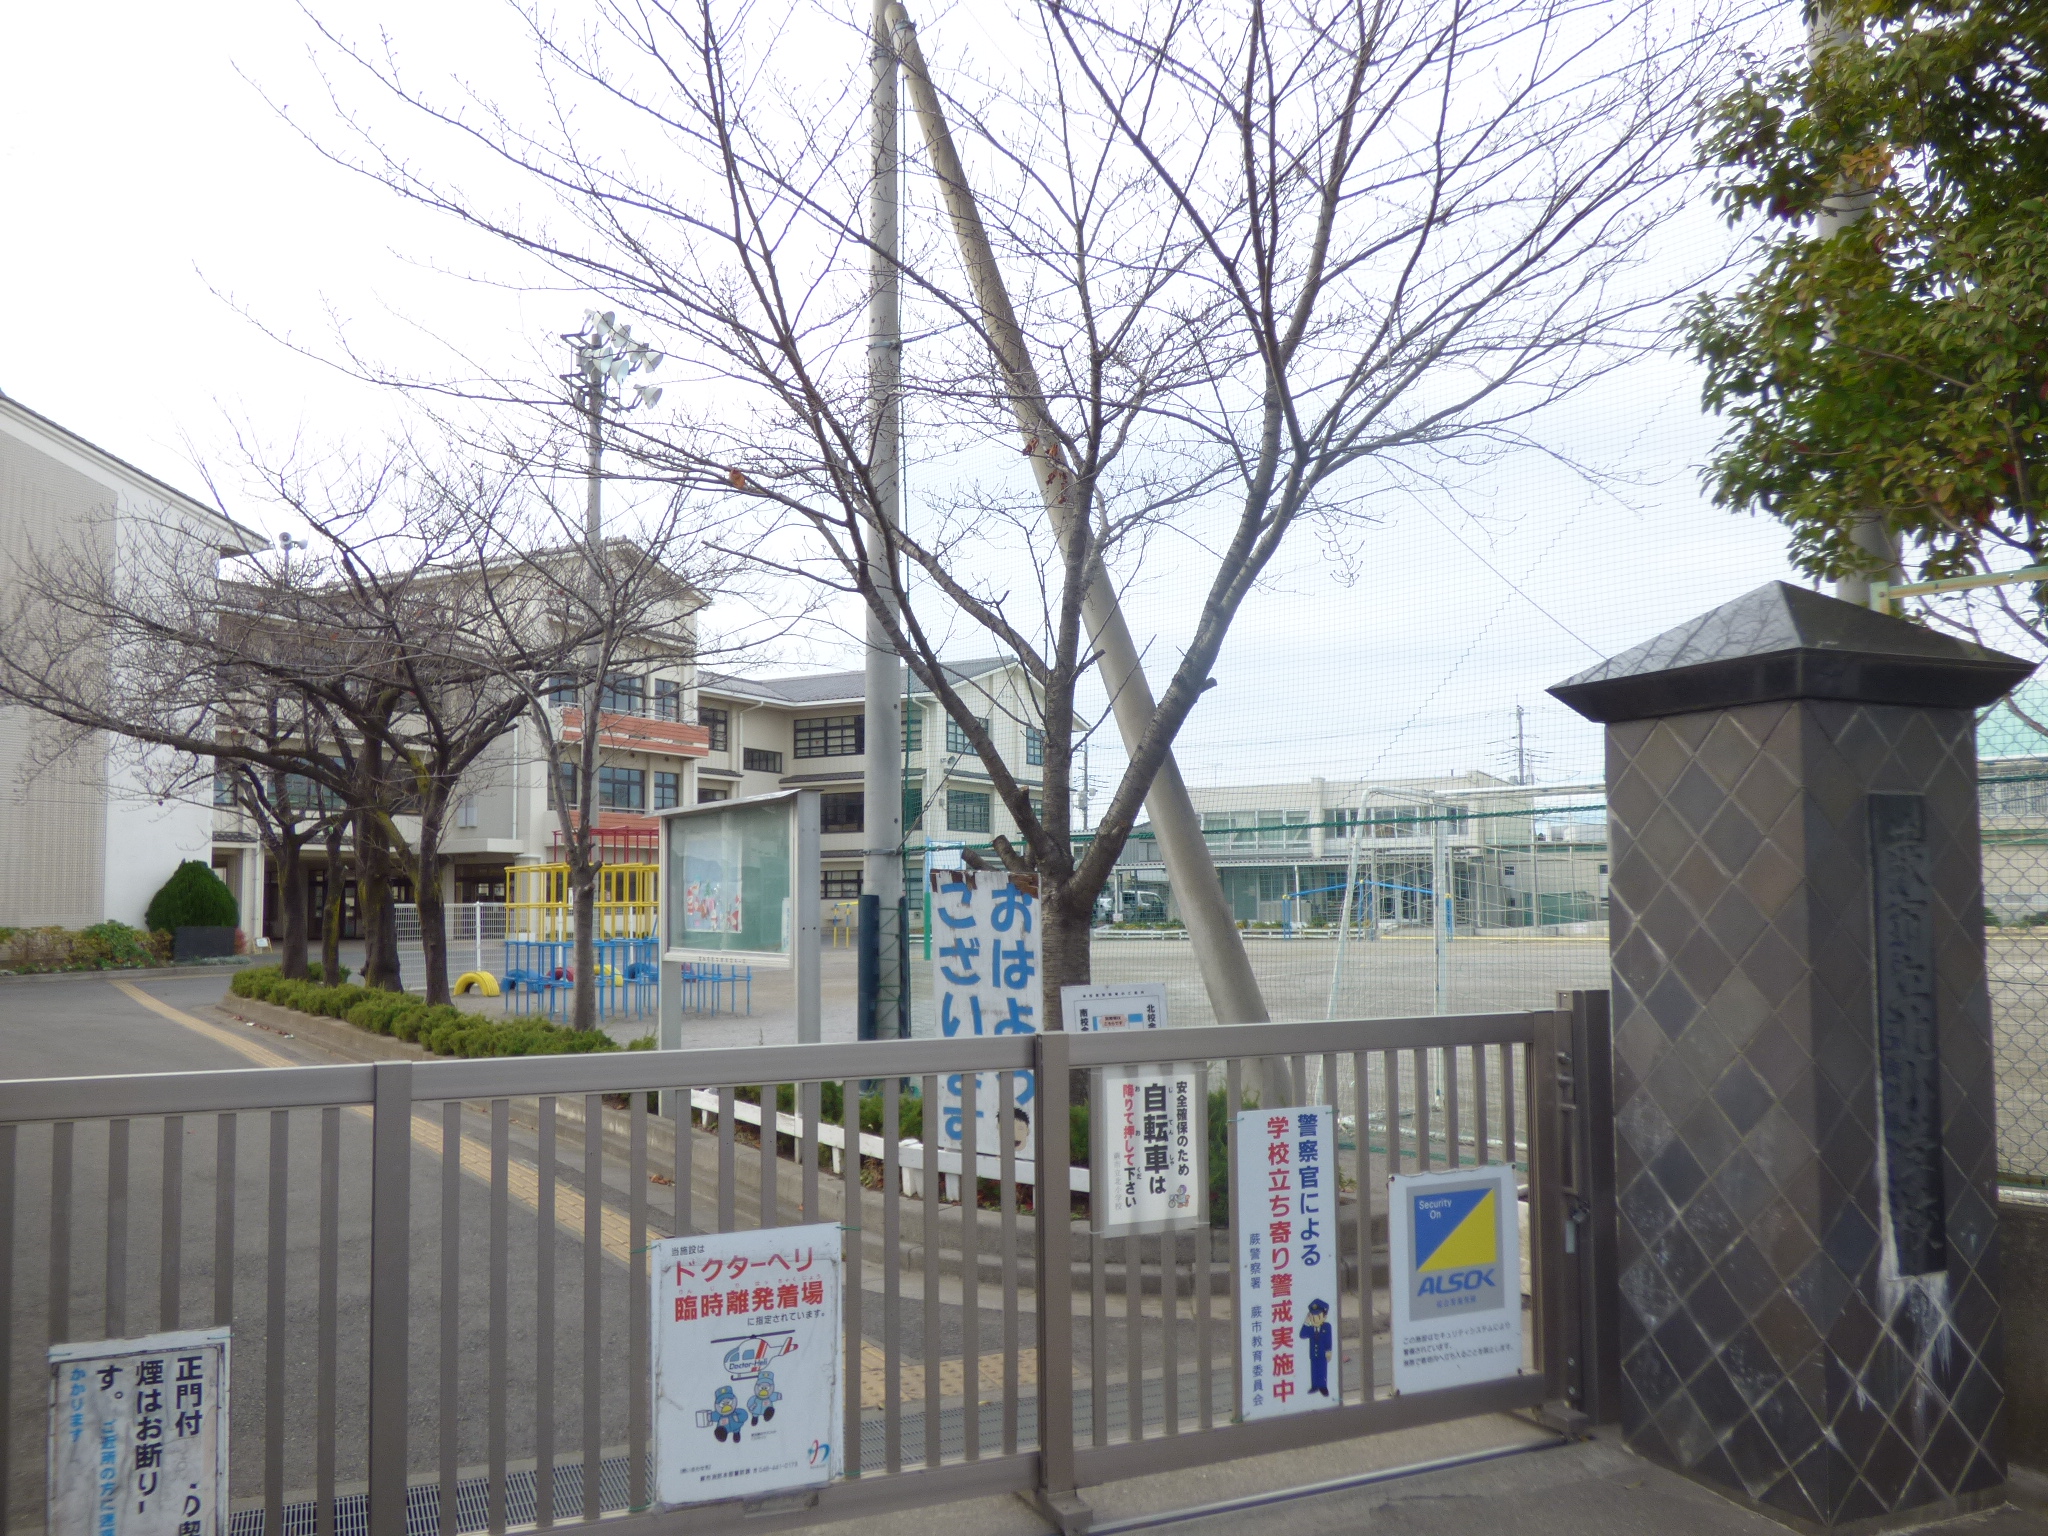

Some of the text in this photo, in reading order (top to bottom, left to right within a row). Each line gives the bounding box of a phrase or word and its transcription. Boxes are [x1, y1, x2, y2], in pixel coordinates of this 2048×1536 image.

[1122, 1084, 1137, 1208] 降りて押して下さい
[1143, 1083, 1169, 1195] 自転車は
[1176, 1081, 1190, 1176] 安全確保のため
[1297, 1113, 1321, 1267] 警察官による
[1419, 1198, 1452, 1211] Security
[1429, 1209, 1442, 1220] On
[671, 1244, 705, 1257] 当施設は
[676, 1247, 814, 1287] ドクターヘリ
[1267, 1116, 1295, 1404] 学校立ち寄り警戒実施中
[675, 1280, 824, 1323] 臨時離発着場
[1417, 1268, 1497, 1297] ALSOK
[747, 1308, 826, 1327] に指定されています。
[1249, 1233, 1264, 1407] 蕨警察署 蕨市教育委員会
[729, 1357, 768, 1371] Doctor-Heli
[69, 1367, 87, 1443] かかります
